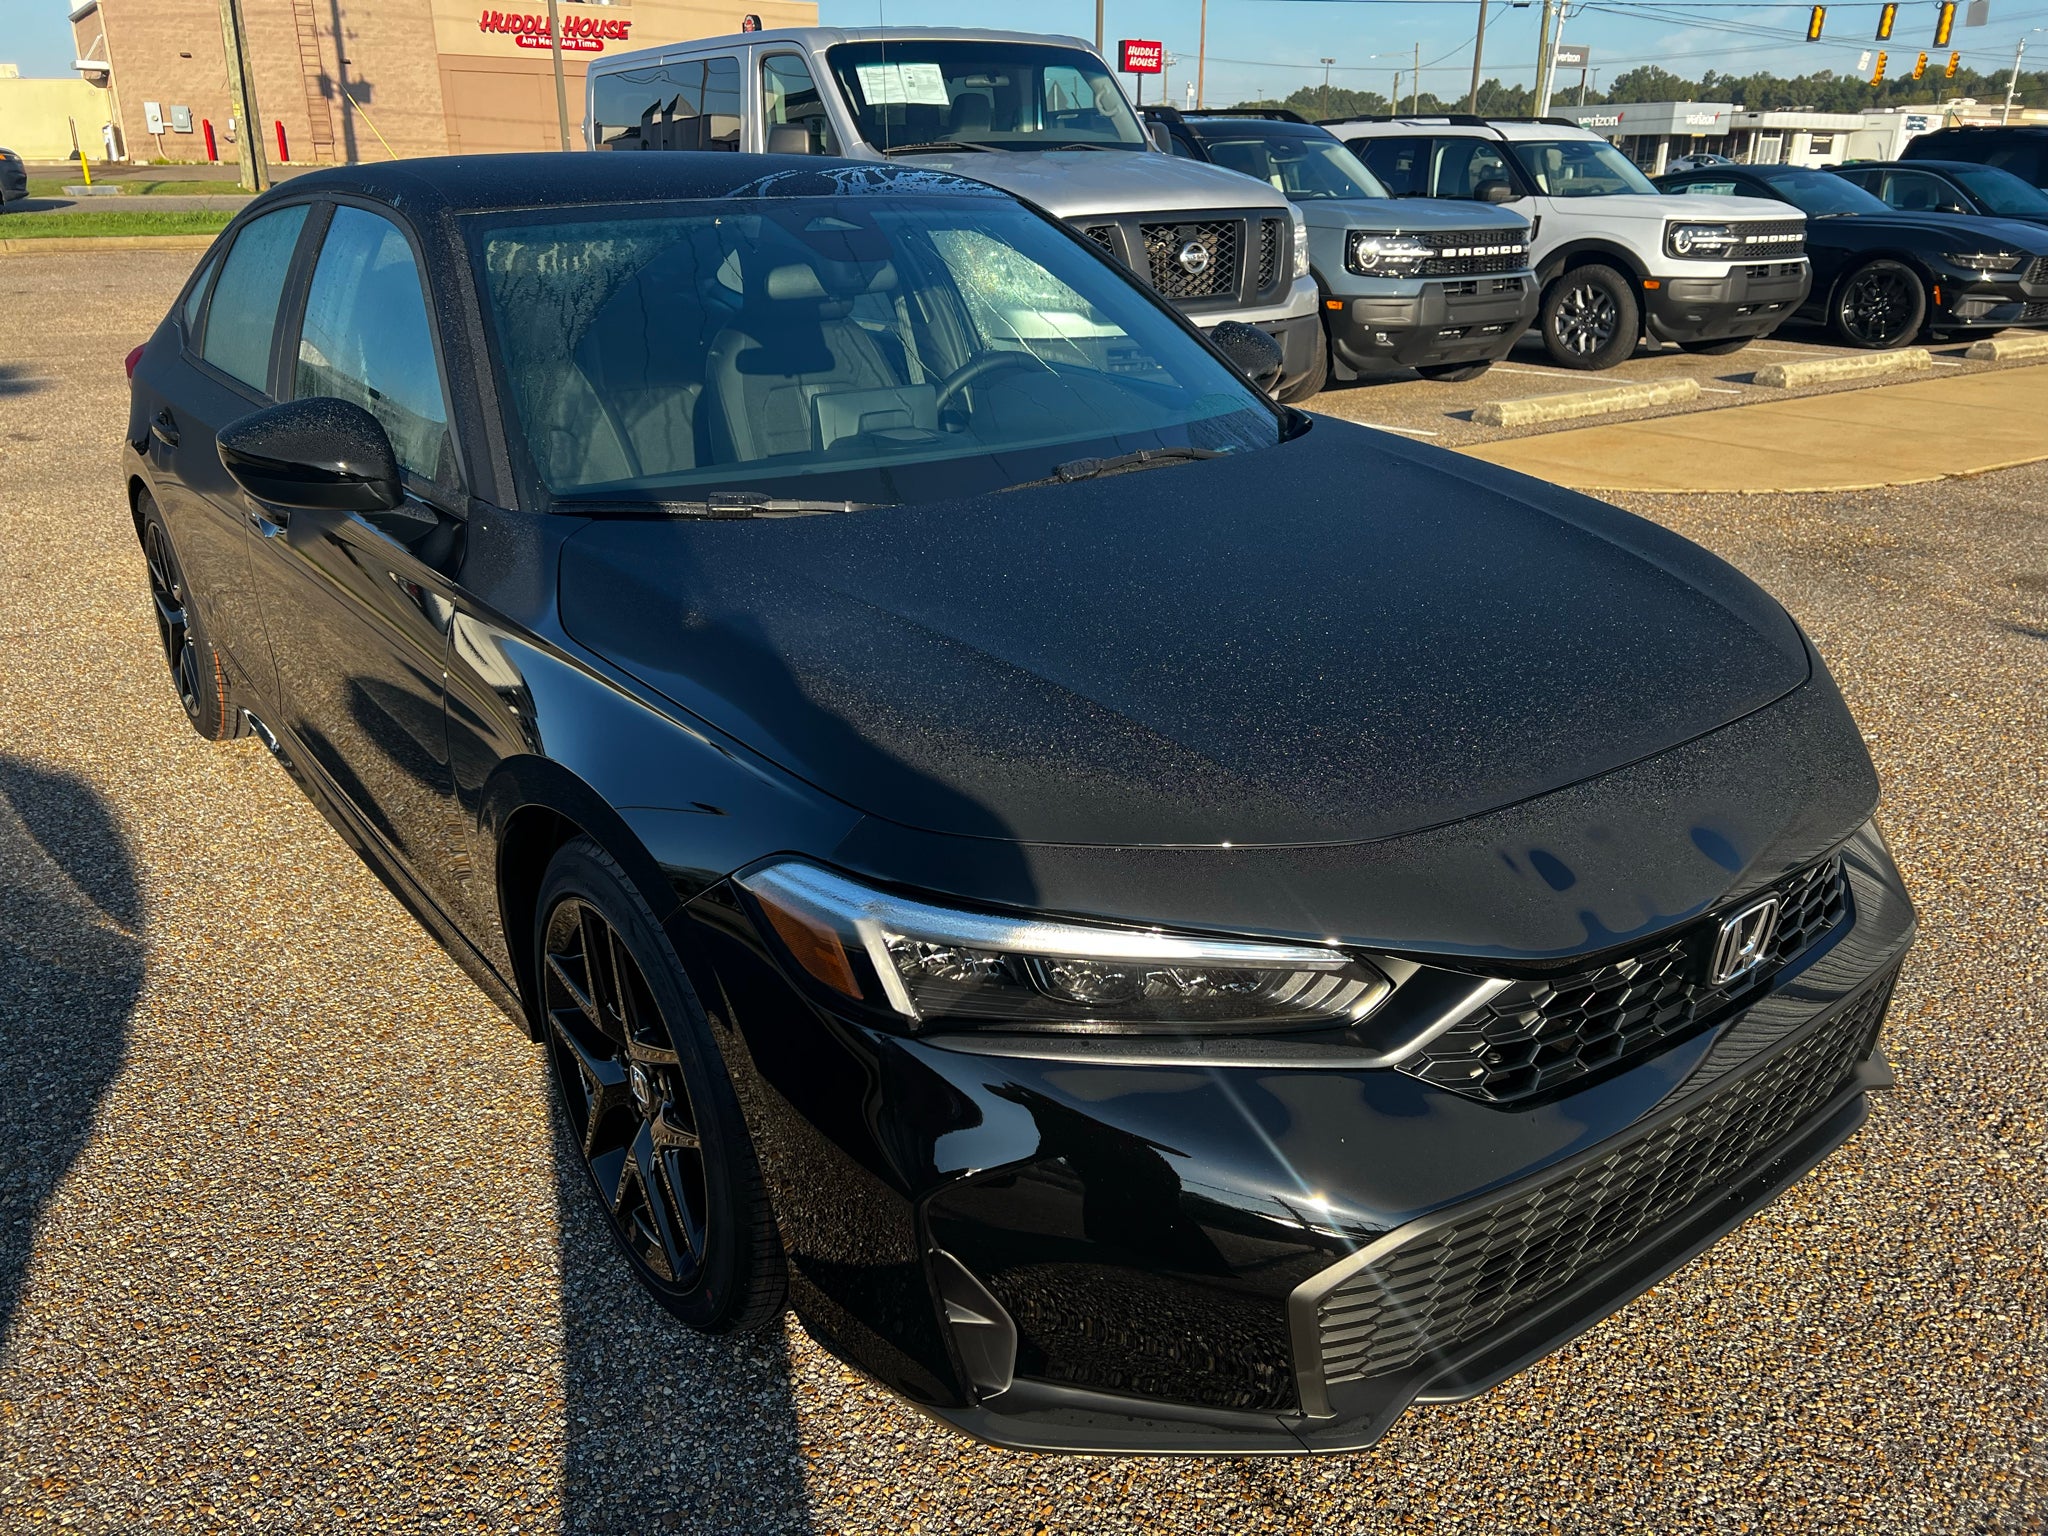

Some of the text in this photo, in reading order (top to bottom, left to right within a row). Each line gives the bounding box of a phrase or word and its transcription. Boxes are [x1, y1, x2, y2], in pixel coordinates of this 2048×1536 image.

[563, 15, 631, 40] HOUSE
[522, 36, 537, 46] Any
[561, 38, 576, 48] Any
[577, 39, 599, 48] Time.
[1128, 46, 1160, 57] HUDDLE
[1129, 56, 1158, 67] HOUSE
[1686, 112, 1716, 125] verizon
[1745, 234, 1803, 244] BRONCO
[1442, 245, 1522, 257] BRONCO
